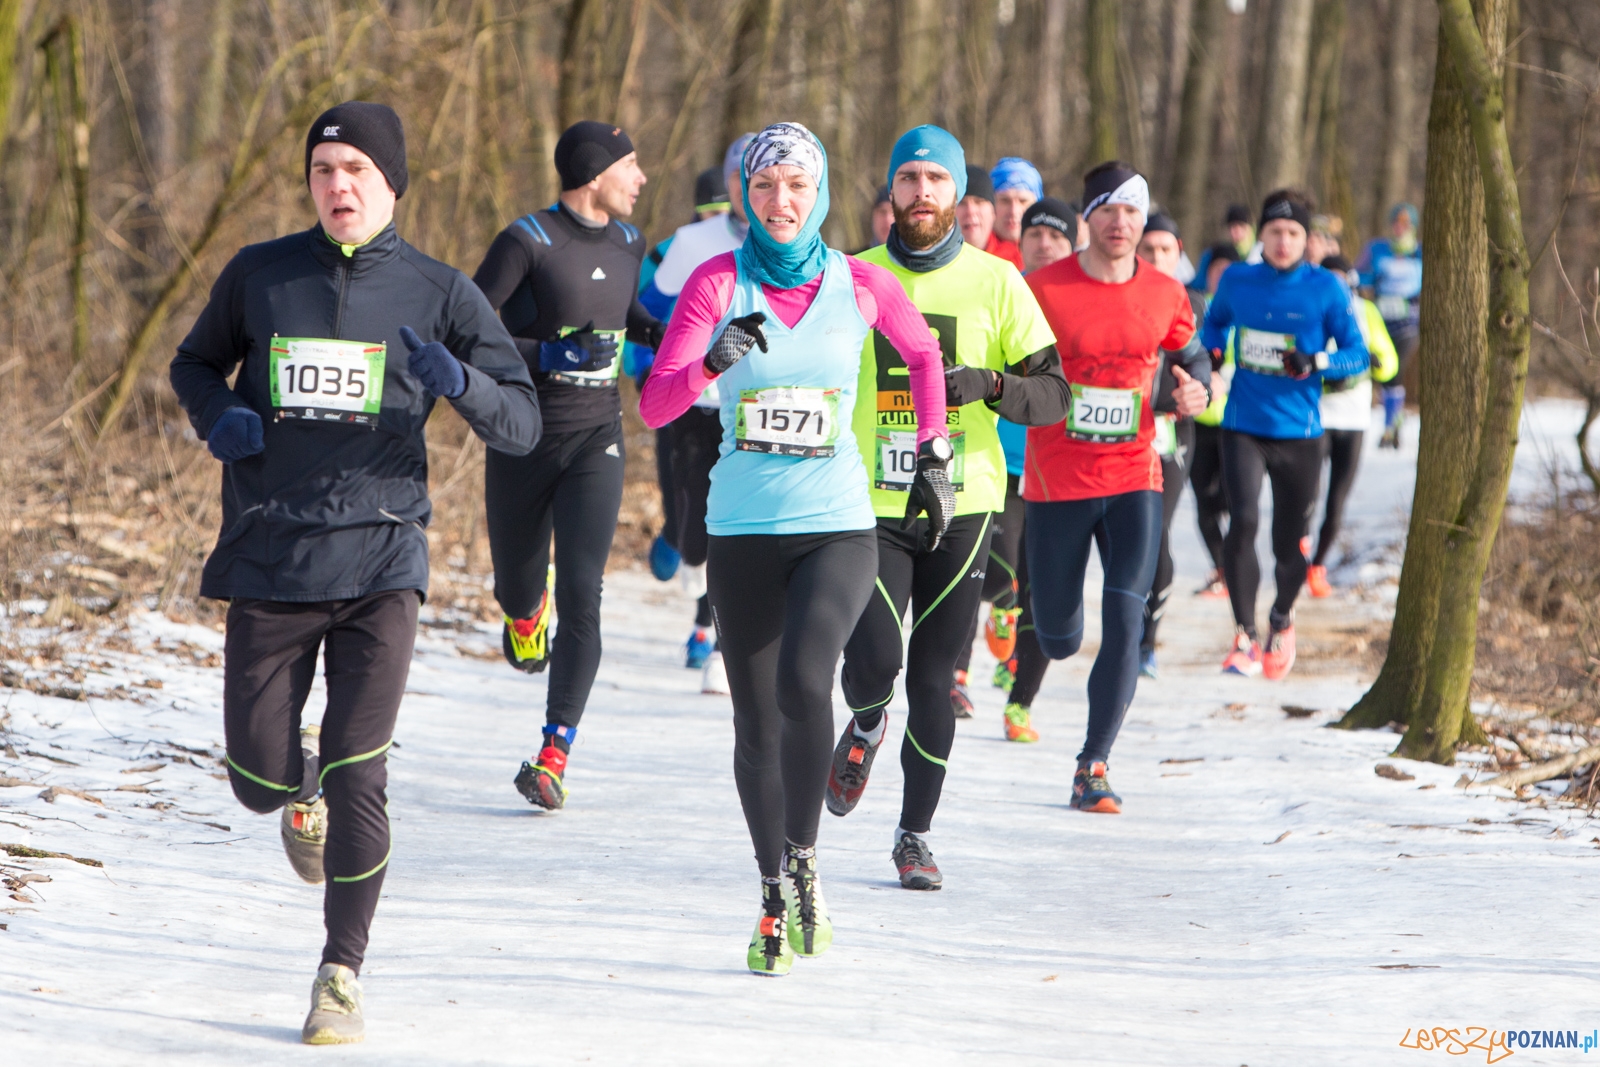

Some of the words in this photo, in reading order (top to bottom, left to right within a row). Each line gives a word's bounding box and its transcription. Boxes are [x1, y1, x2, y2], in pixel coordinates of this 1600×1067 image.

[914, 148, 930, 157] 4F
[284, 364, 366, 399] 1035
[757, 408, 824, 436] 1571
[1080, 403, 1130, 425] 2001
